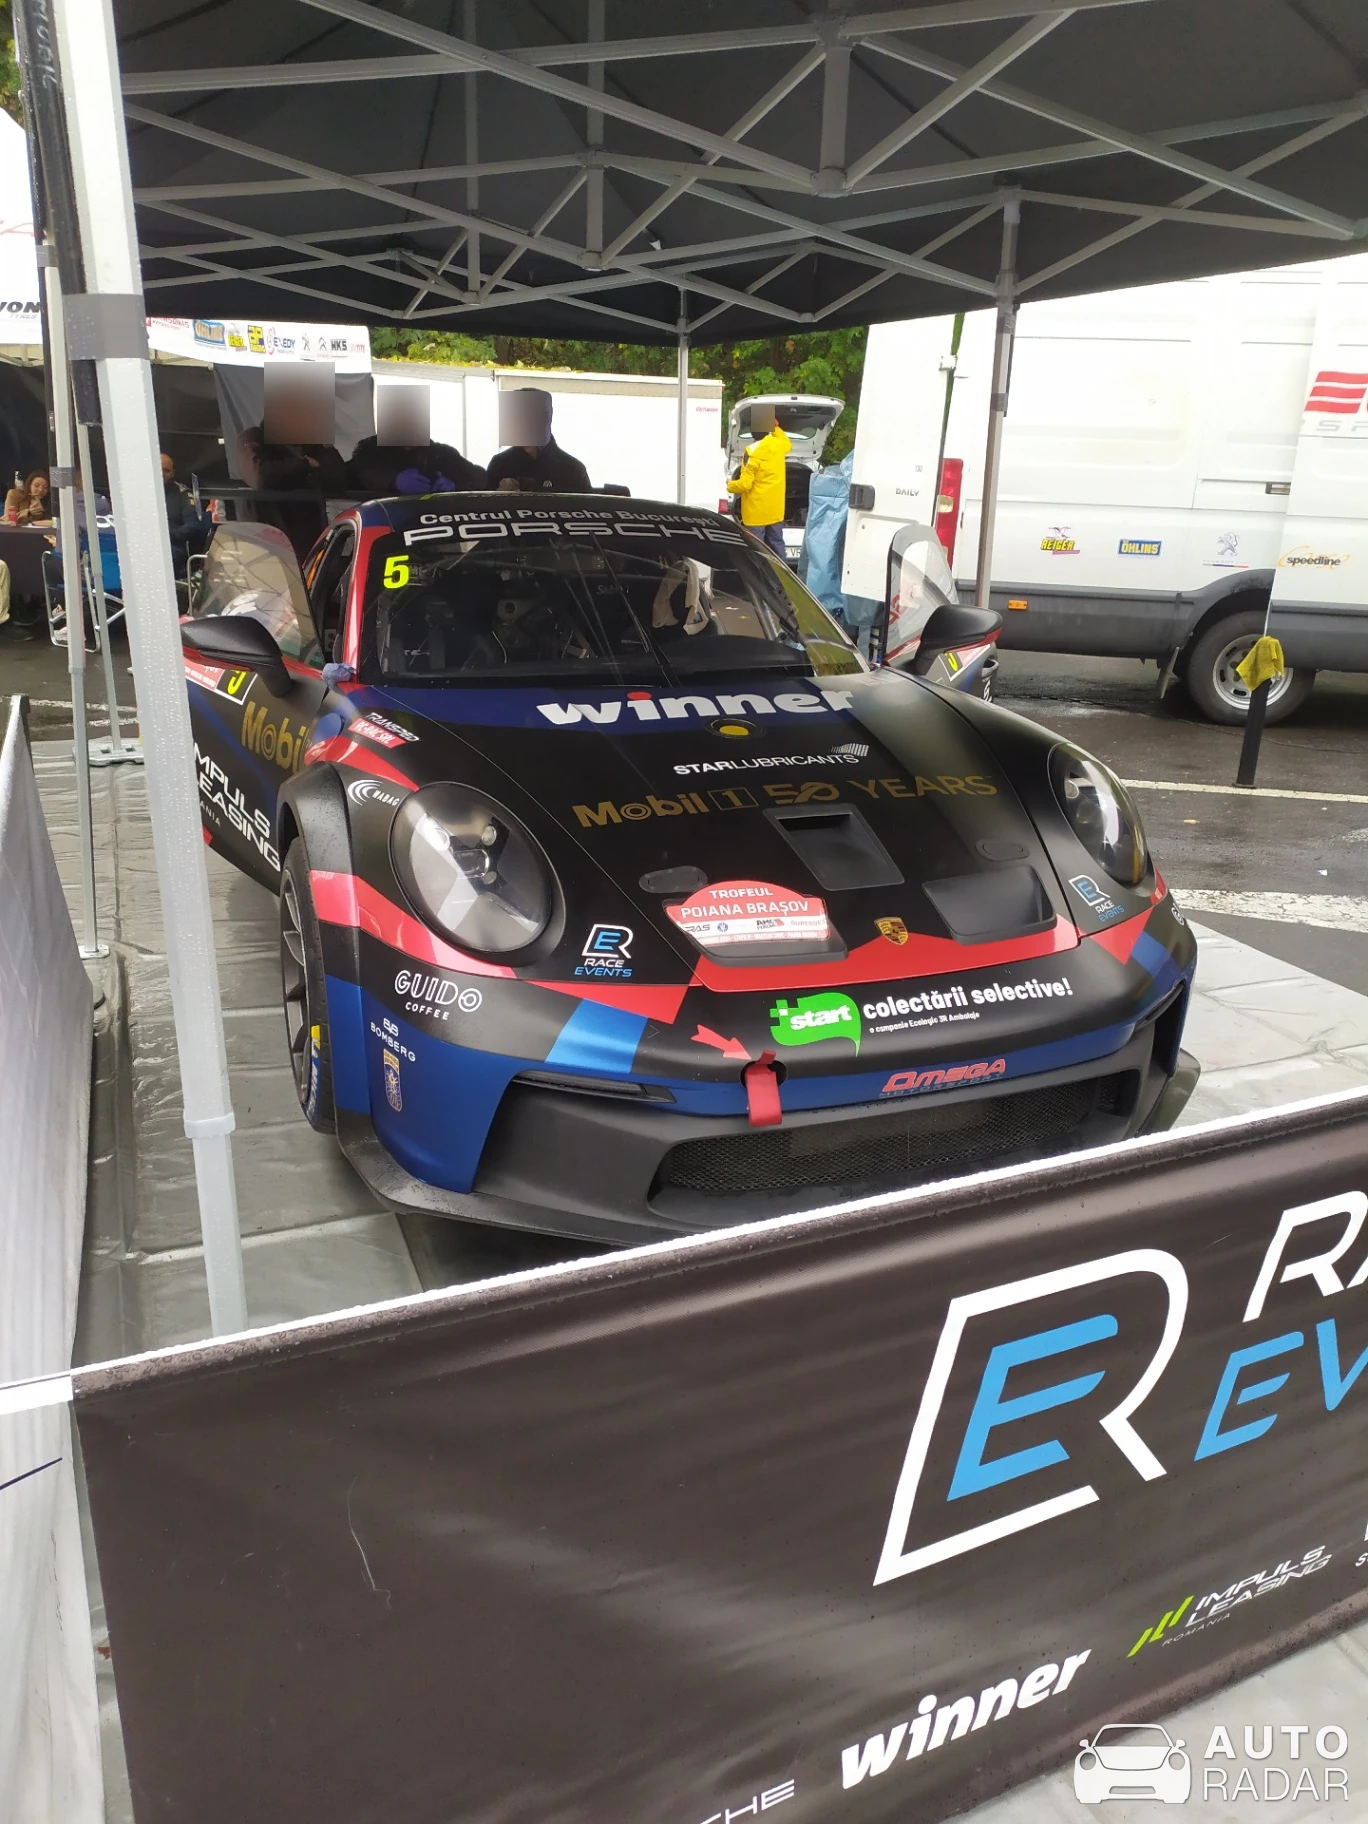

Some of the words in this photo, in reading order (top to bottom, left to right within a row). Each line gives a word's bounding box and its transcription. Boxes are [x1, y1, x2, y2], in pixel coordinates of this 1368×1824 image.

[896, 488, 920, 496] DAILY
[420, 510, 512, 524] Centrul
[516, 508, 613, 519] Porsche
[404, 521, 748, 547] PORSCHE
[1041, 538, 1076, 550] REIGER
[383, 555, 409, 589] 5
[1287, 555, 1341, 566] speedline
[536, 691, 855, 725] winner
[673, 754, 859, 775] STARLUBRICANTS
[194, 741, 271, 839] MPULS
[372, 789, 400, 806] WABAG
[572, 792, 709, 828] Mobil
[848, 775, 999, 799] YEARS
[198, 771, 281, 872] EASING
[708, 887, 774, 899] TROFEUL
[681, 905, 743, 919] POIANA
[747, 901, 808, 916] BRAȘOV
[1095, 899, 1115, 914] RACE
[1098, 905, 1125, 921] EVENTS
[574, 967, 633, 978] EVENTS
[584, 958, 625, 968] RACE
[395, 970, 483, 1013] GUIDO
[863, 985, 969, 1019] colectării
[971, 977, 1074, 1006] selective!
[405, 1001, 450, 1021] COFFEE
[789, 1004, 853, 1032] start
[876, 1021, 908, 1033] companie
[370, 1021, 416, 1062] BOMBERG
[1243, 1190, 1368, 1322] R
[1185, 1553, 1333, 1628] LEASING
[1195, 1545, 1326, 1611] IMPULS
[1162, 1612, 1231, 1647] ROMANIA
[841, 1648, 1093, 1790] winner
